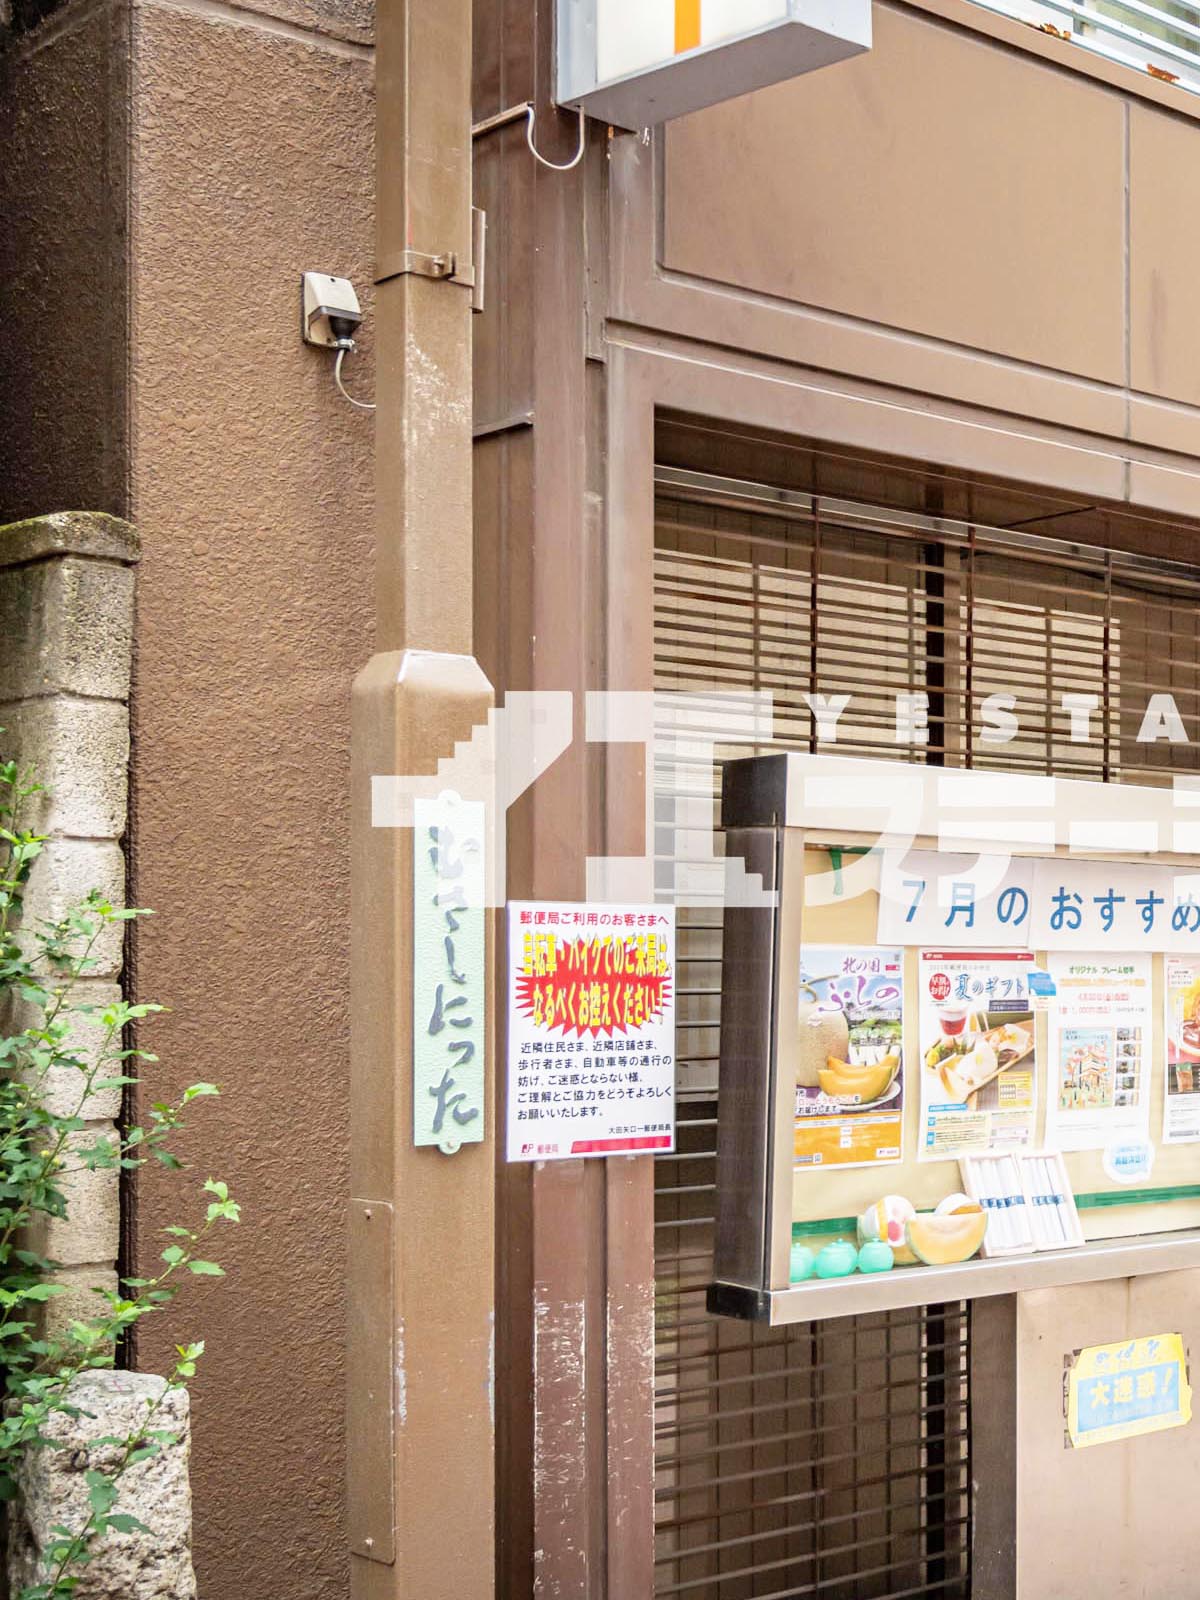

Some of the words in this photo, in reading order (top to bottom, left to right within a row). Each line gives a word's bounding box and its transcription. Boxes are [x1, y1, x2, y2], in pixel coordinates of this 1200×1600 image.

[519, 911, 669, 926] 郵便局ご利用のお客さまへ
[954, 973, 1025, 1001] 夏のギフト
[518, 1055, 672, 1071] 歩行者さま、自動車等の通行の
[517, 1086, 672, 1104] ご理解とご協力をどうぞよろしく
[517, 1106, 604, 1121] お願いいたします。
